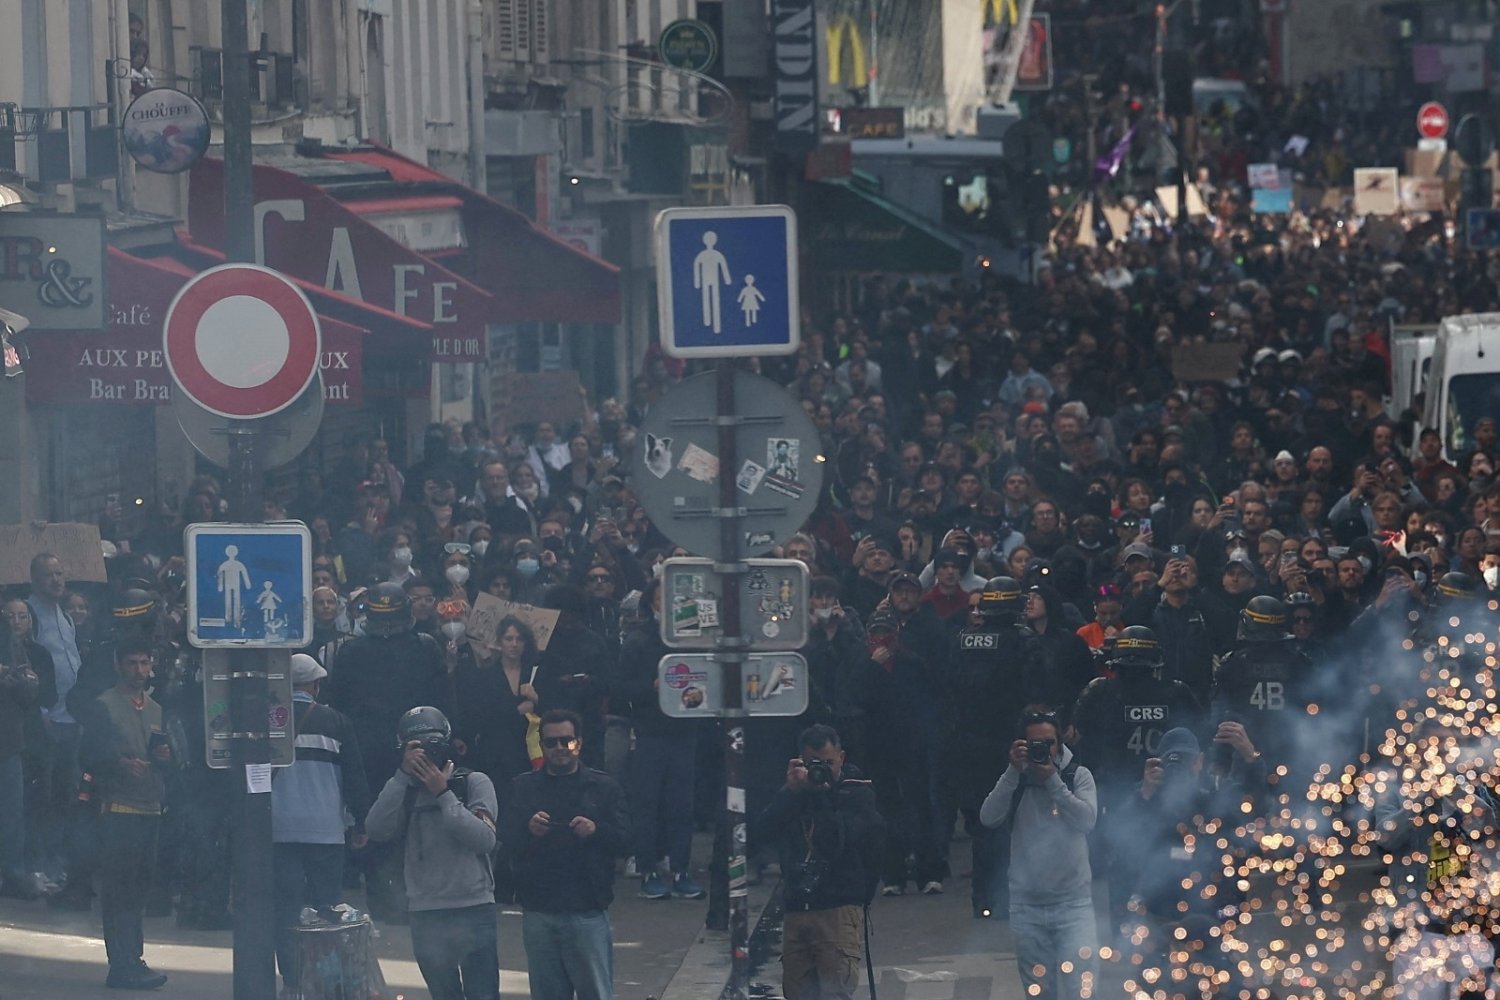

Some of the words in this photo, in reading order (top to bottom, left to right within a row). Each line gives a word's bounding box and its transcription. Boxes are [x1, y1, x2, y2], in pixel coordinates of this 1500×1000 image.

[775, 0, 812, 134] NDIN
[453, 338, 480, 355] D'OR
[79, 349, 128, 367] AUX
[136, 350, 164, 368] PE
[90, 378, 125, 400] Bar
[323, 382, 349, 400] nt
[964, 635, 994, 647] CRS
[1249, 681, 1286, 711] 4B
[1130, 707, 1164, 721] CRS
[1127, 726, 1163, 755] 4C
